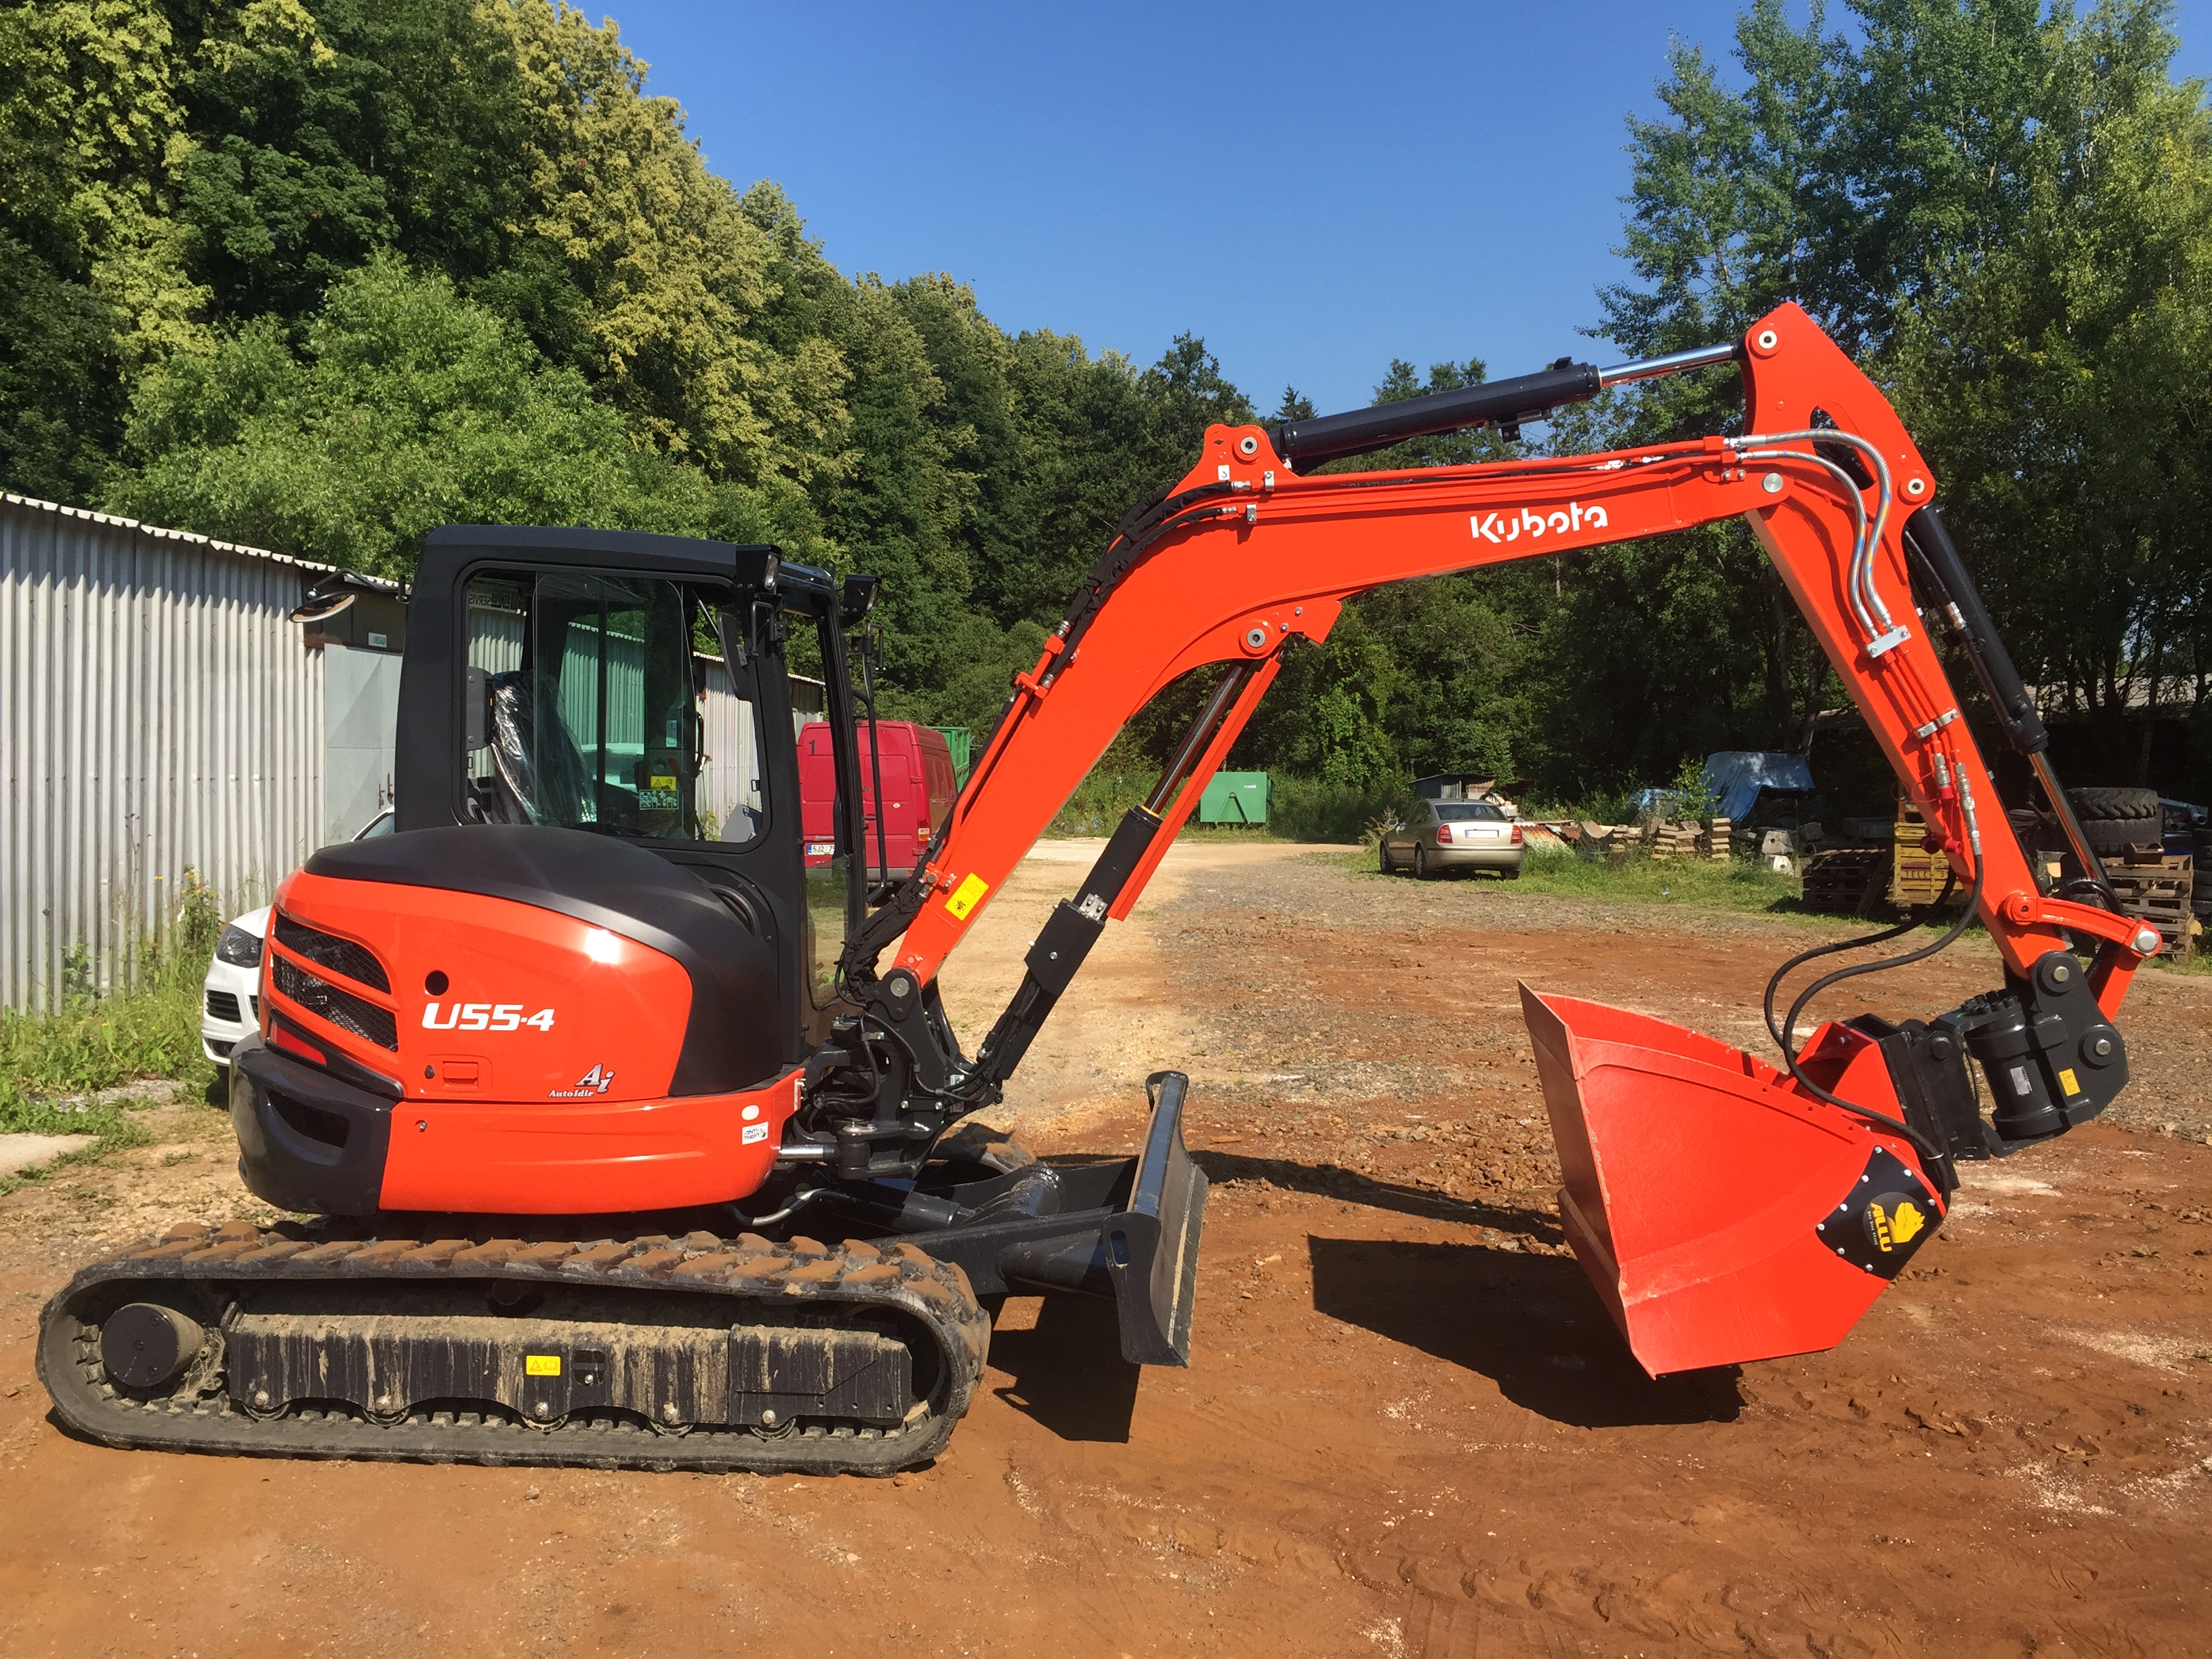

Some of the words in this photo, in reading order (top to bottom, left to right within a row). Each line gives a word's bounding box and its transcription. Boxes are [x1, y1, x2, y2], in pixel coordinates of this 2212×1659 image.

[1470, 501, 1608, 544] Kubota
[808, 739, 815, 755] 1
[422, 1002, 555, 1031] U55-4
[574, 1063, 615, 1093] Ai
[548, 1089, 594, 1097] AutoIdle
[1870, 1202, 1892, 1252] ALLU
